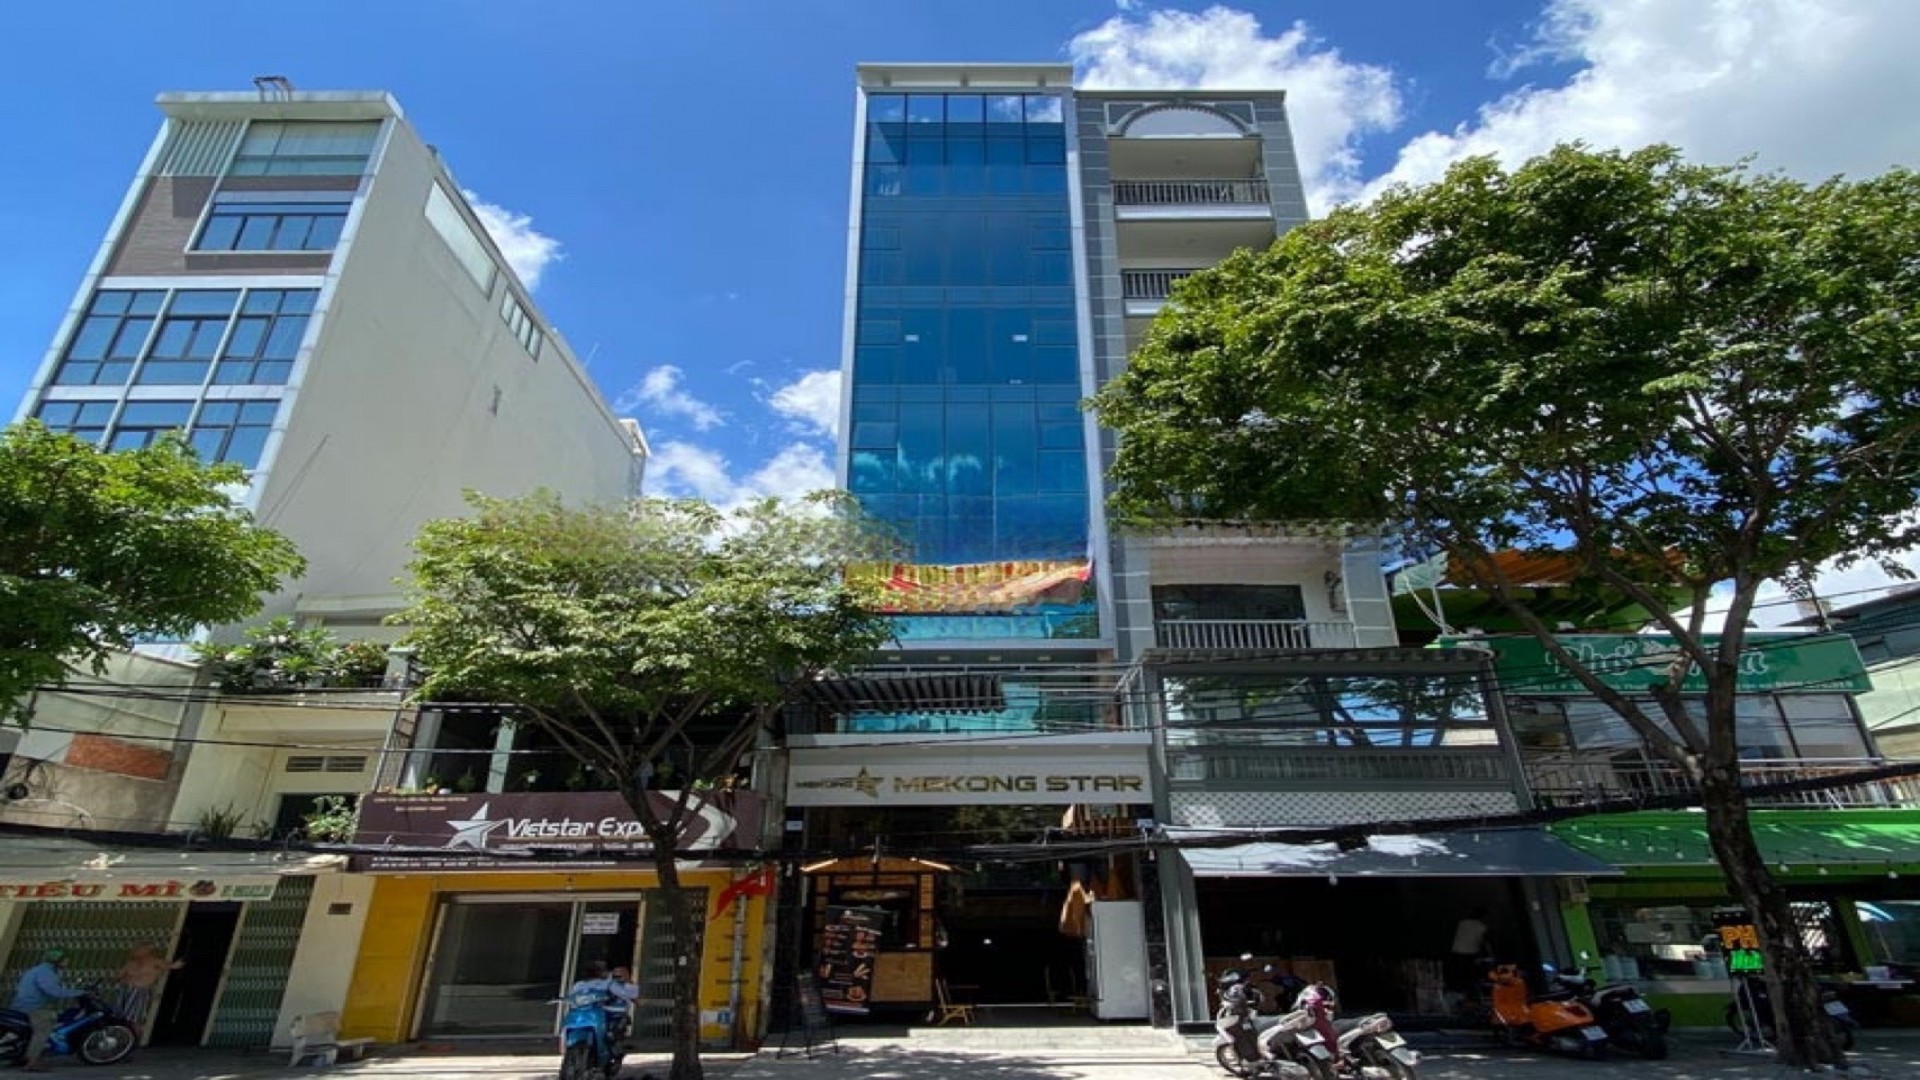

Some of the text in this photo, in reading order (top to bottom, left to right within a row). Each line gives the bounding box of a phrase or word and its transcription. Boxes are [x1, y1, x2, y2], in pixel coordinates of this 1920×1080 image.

[893, 776, 1143, 792] MEKONG STAR
[506, 817, 594, 837] Vietstar
